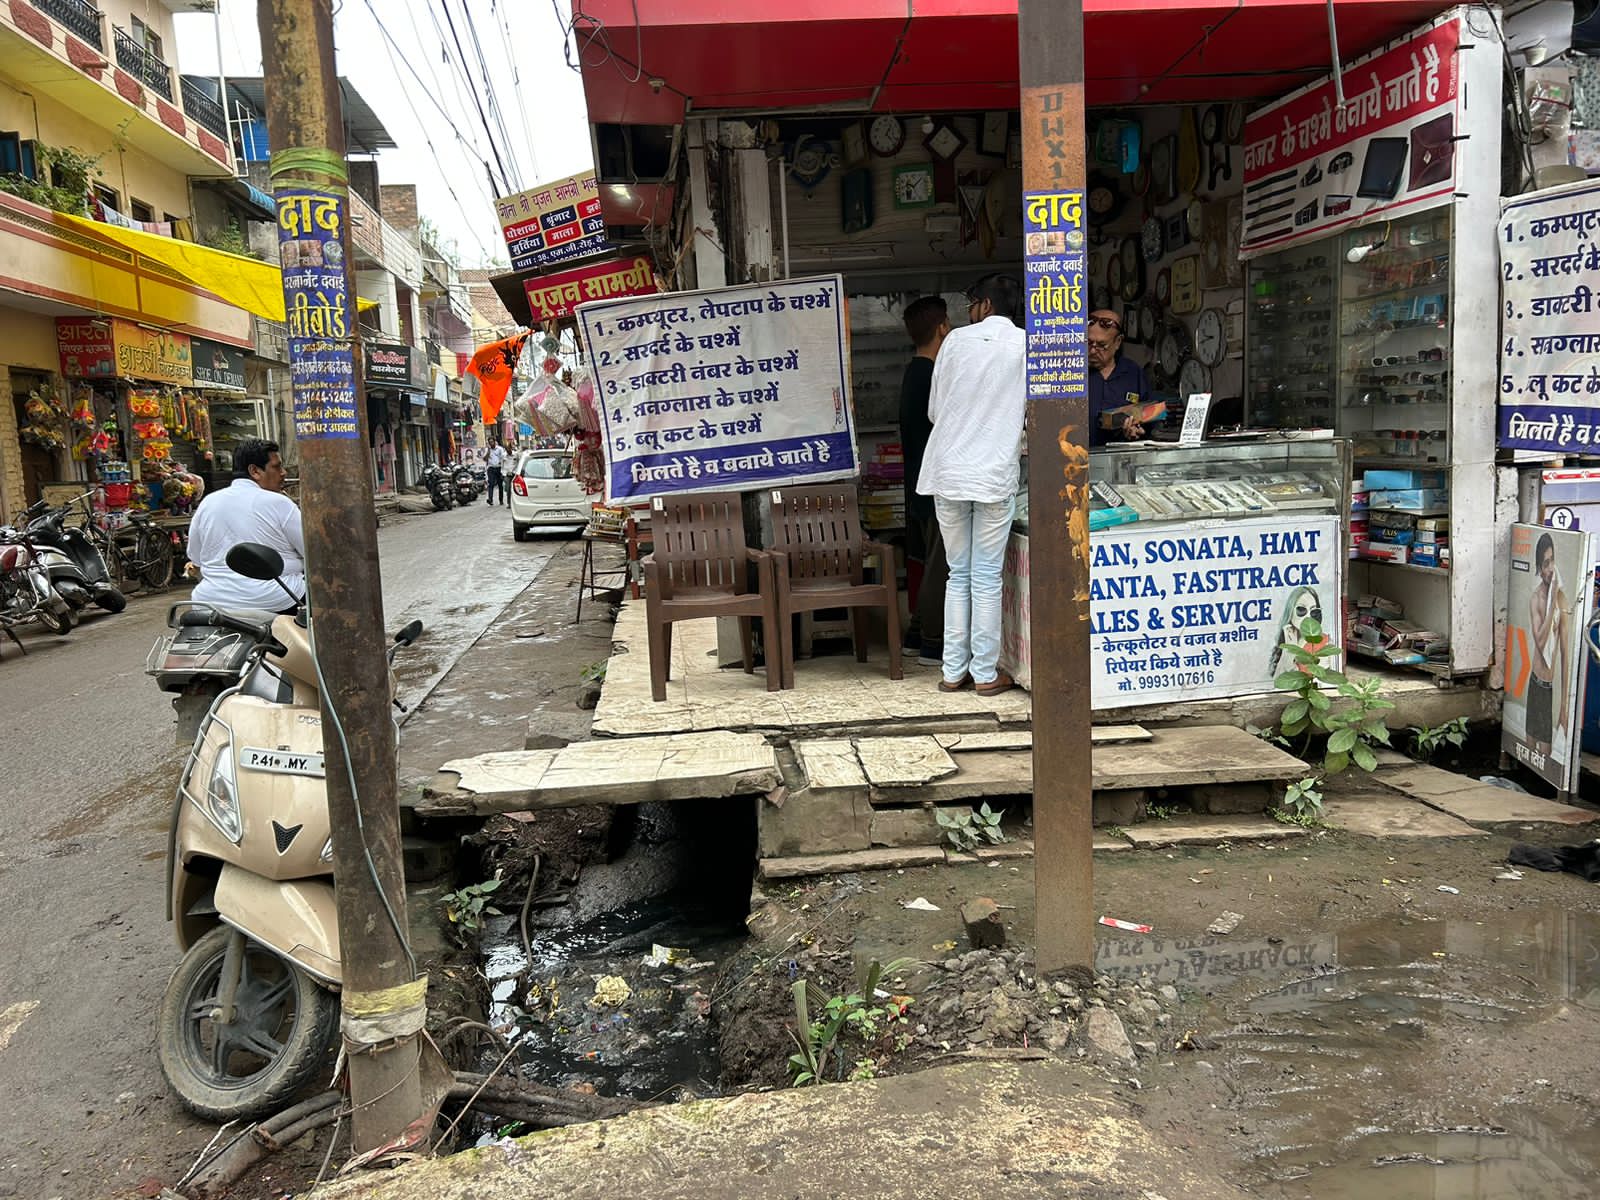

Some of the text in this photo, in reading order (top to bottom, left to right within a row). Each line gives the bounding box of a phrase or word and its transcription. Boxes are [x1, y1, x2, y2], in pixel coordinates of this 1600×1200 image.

[1244, 135, 1277, 170] नजर
[1281, 116, 1296, 157] के
[1298, 97, 1333, 149] चश्मे
[1385, 52, 1422, 111] जाते
[532, 191, 553, 209] पूजन
[554, 178, 580, 201] सामग्री
[277, 195, 339, 239] दाद
[1026, 193, 1083, 230] दाद
[506, 223, 538, 238] पोशाक
[551, 227, 574, 240] माला
[517, 257, 532, 268] पता
[1063, 255, 1083, 272] दवाई
[1531, 244, 1584, 278] सरदर्द
[321, 272, 345, 291] दवाई
[528, 257, 653, 317] पूजन सामग्री
[1029, 273, 1083, 314] लीबोर्ड
[287, 291, 345, 338] लीबोर्ड
[699, 298, 763, 320] लेपटाप
[767, 292, 785, 312] के
[789, 287, 833, 311] चश्में
[1531, 285, 1592, 316] डाक्टरी
[623, 338, 671, 361] सरदर्द
[674, 332, 694, 353] के
[699, 325, 741, 348] चश्में
[196, 366, 212, 381] SHOE
[213, 370, 222, 382] ON
[223, 371, 244, 387] DEMAND
[629, 363, 687, 390] डाक्टरी
[690, 359, 732, 380] नंबर
[734, 355, 754, 375] के
[757, 349, 799, 372] चश्में
[714, 387, 734, 408] के
[737, 381, 779, 404] चश्में
[1525, 375, 1550, 401] लू
[1551, 375, 1584, 394] कट
[662, 425, 694, 444] कट
[697, 419, 718, 439] के
[721, 412, 763, 436] चश्में
[1508, 412, 1558, 441] मिलते
[1576, 423, 1592, 445] व
[631, 462, 684, 484] मिलते
[705, 460, 719, 476] व
[721, 449, 774, 472] बनाये
[777, 443, 814, 466] जाते
[1090, 530, 1321, 569] AN, SONATA, HMT
[1090, 563, 1320, 601] ANTA, FASTTRACK
[1147, 606, 1165, 630] &
[1171, 599, 1272, 628] SERVICE
[1170, 635, 1181, 648] व
[1184, 632, 1217, 647] वजन
[1219, 626, 1259, 643] मशीन
[1105, 656, 1147, 675] रिपेयर
[1150, 652, 1180, 670] किये
[1183, 650, 1210, 666] जाते
[1117, 670, 1215, 691] मो. 9993107616
